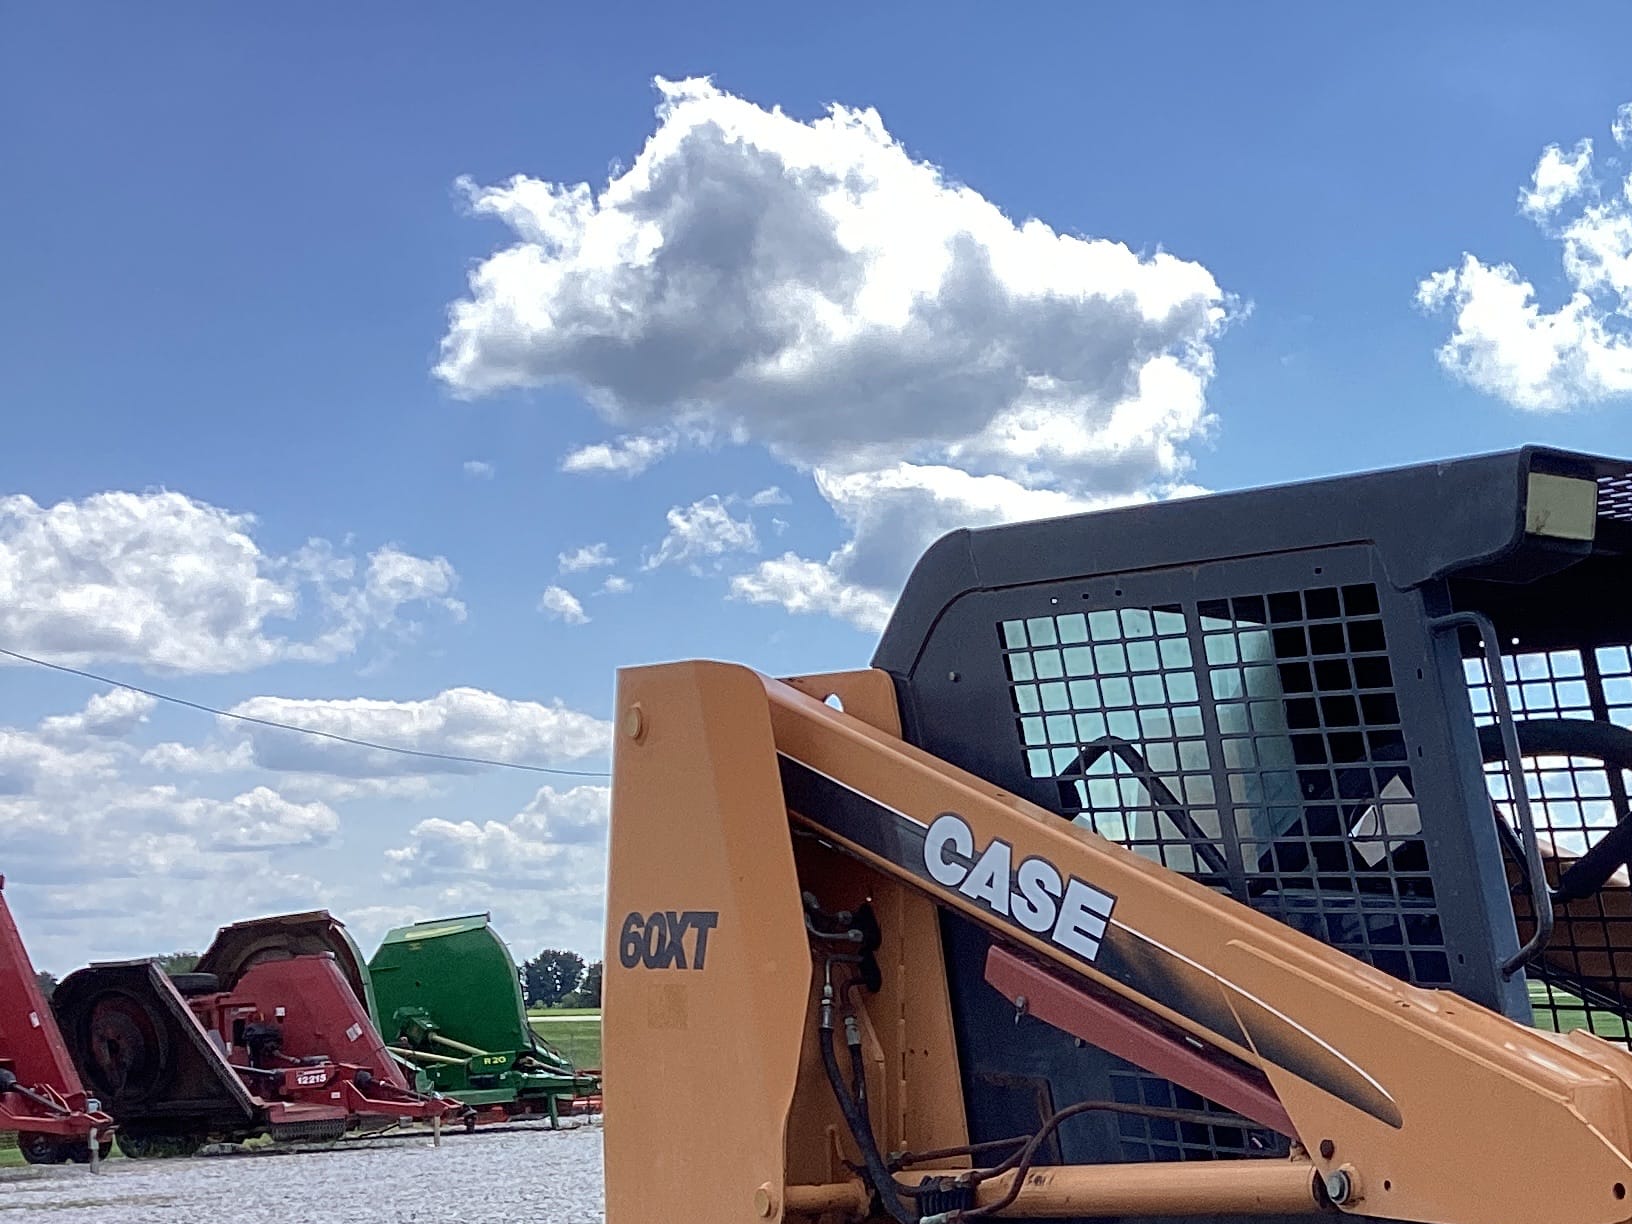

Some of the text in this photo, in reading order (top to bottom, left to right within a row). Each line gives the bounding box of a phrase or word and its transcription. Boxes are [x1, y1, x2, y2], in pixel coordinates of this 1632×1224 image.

[924, 813, 1117, 962] CASE
[620, 911, 719, 970] 60XT
[297, 1073, 327, 1085] 12215
